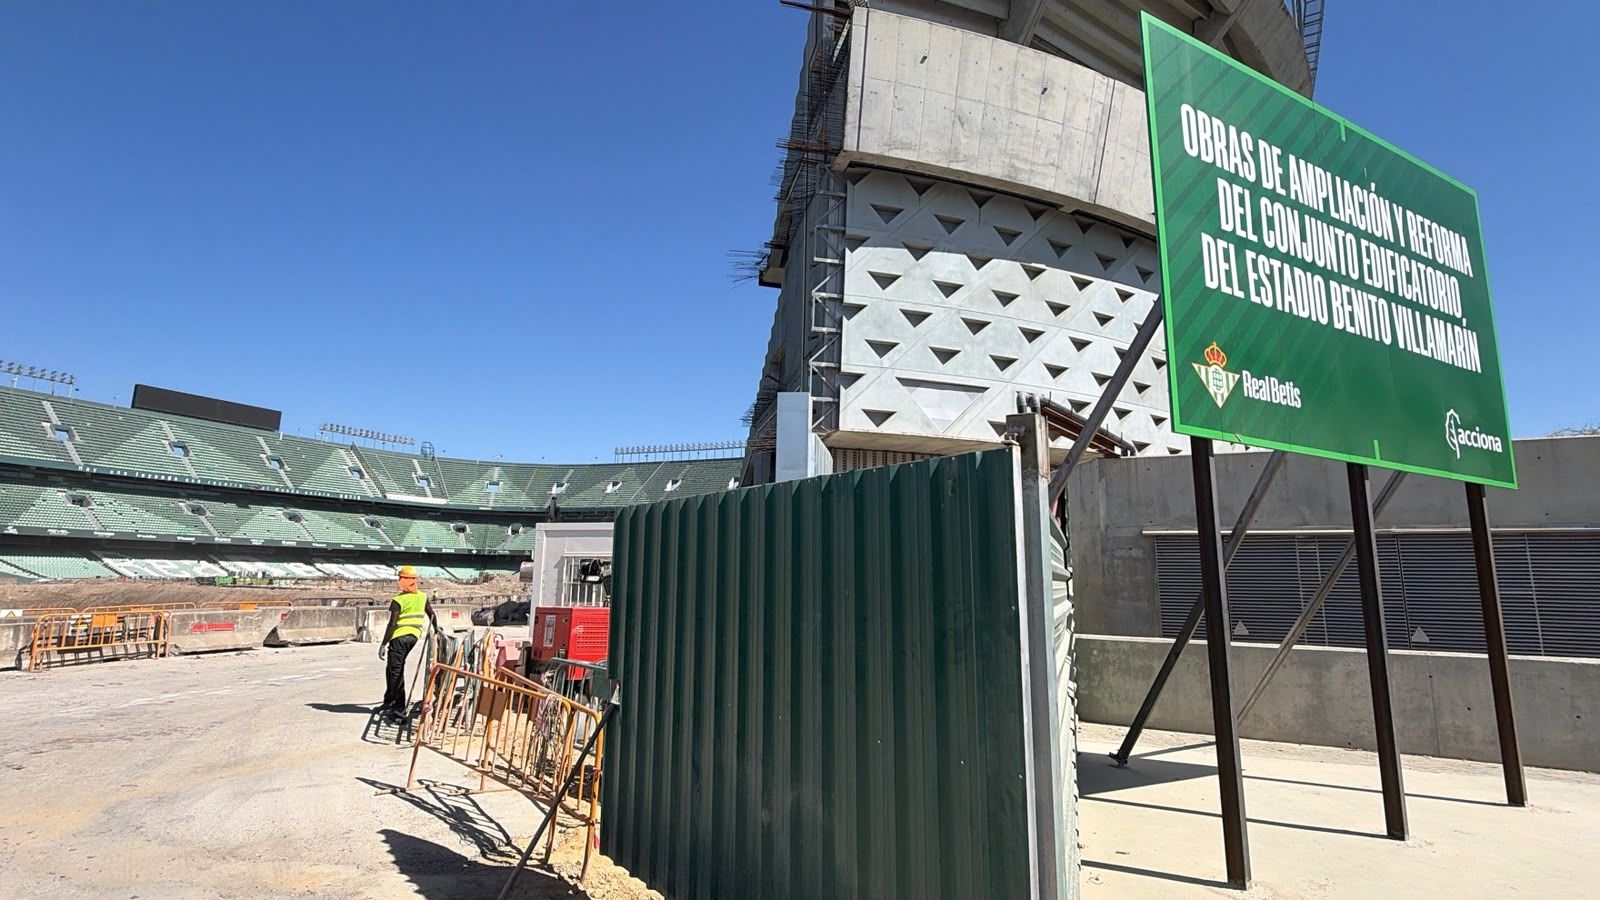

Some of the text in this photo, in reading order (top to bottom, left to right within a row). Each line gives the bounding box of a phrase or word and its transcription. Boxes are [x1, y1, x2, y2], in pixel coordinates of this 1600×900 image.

[1180, 103, 1474, 278] OBRAS DE AMPLIACIÓN Y REFORMA
[1216, 177, 1259, 243] DEL
[1259, 196, 1360, 281] CONJUNTO
[1200, 231, 1483, 374] DEL ESTADIO BENITO VILLAMARÍN
[1457, 426, 1503, 453] acciona
